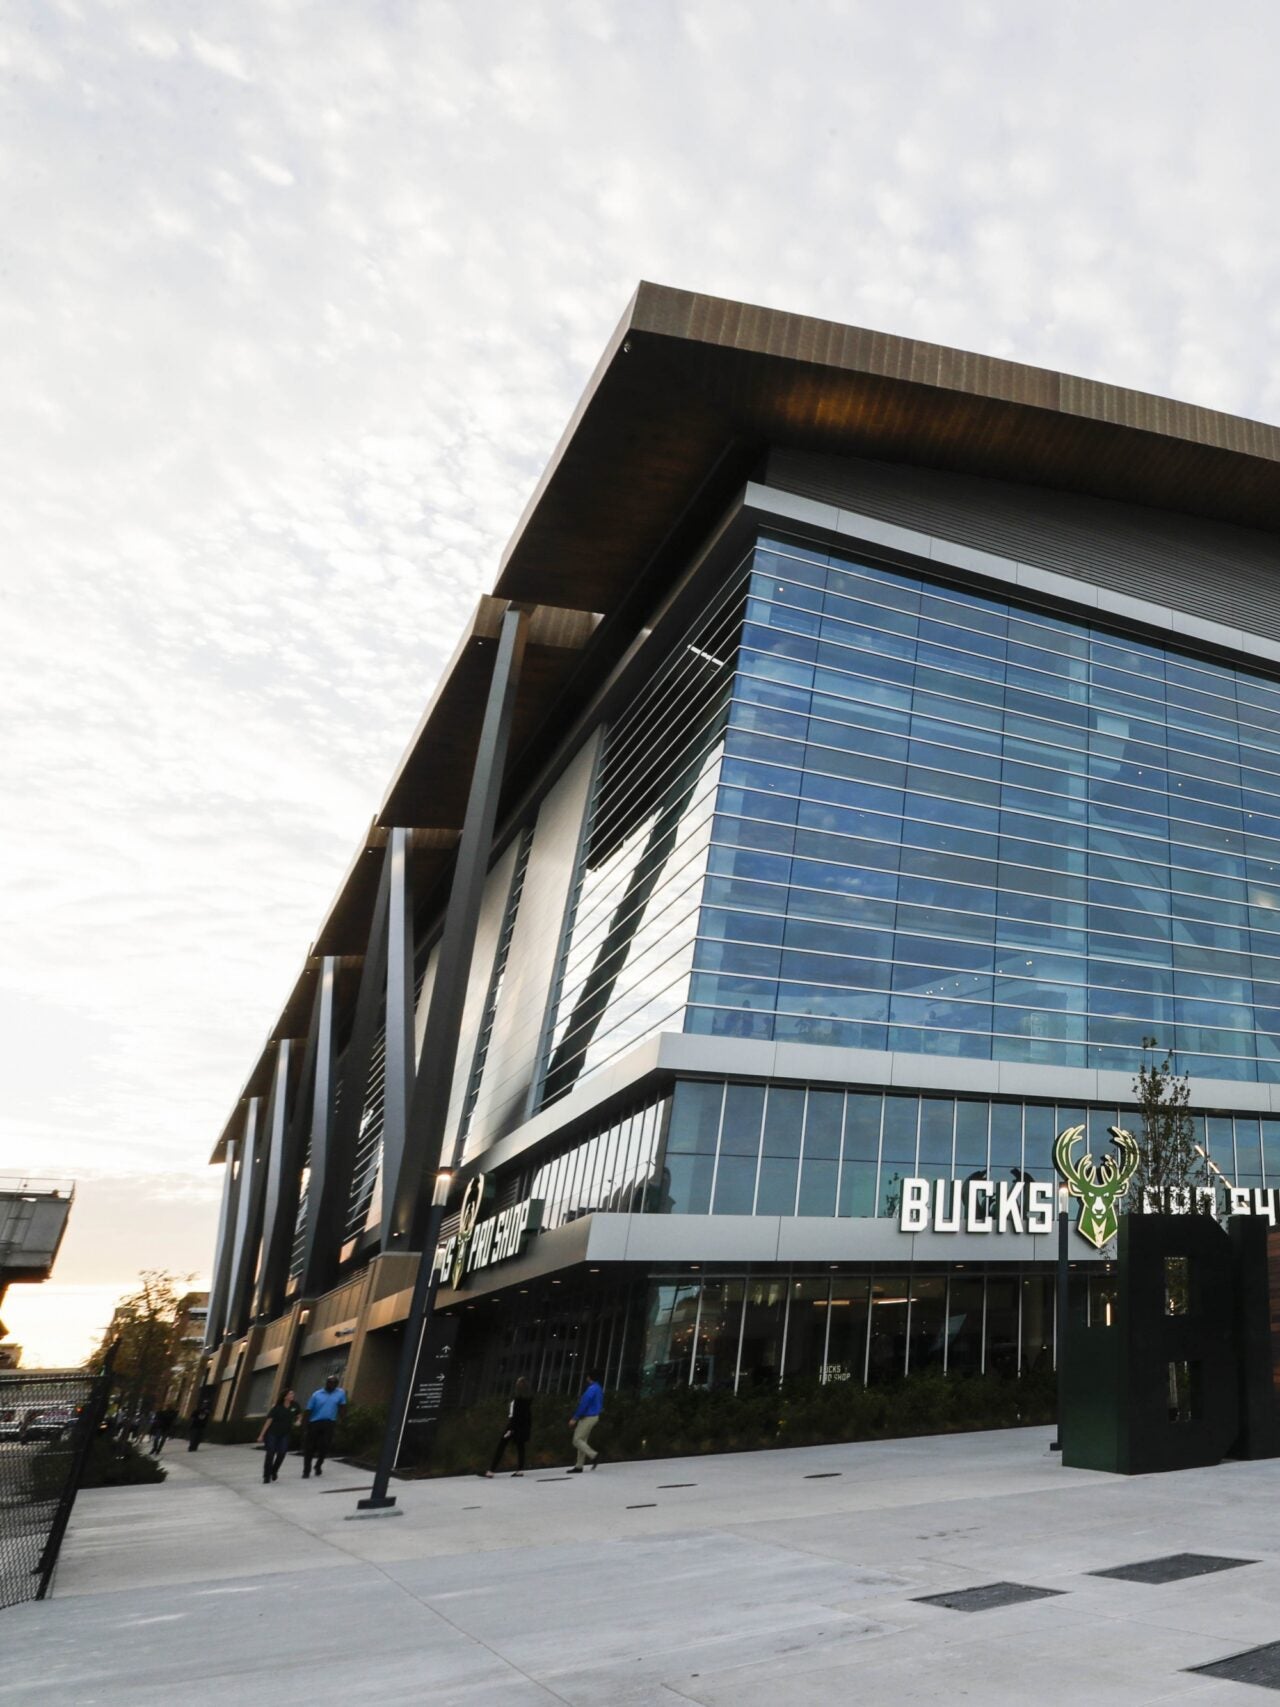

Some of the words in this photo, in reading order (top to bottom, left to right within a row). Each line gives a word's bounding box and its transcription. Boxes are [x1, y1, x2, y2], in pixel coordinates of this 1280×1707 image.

[466, 1215, 497, 1273] PRO
[490, 1197, 531, 1264] SHOP
[900, 1177, 1054, 1234] BUCKS
